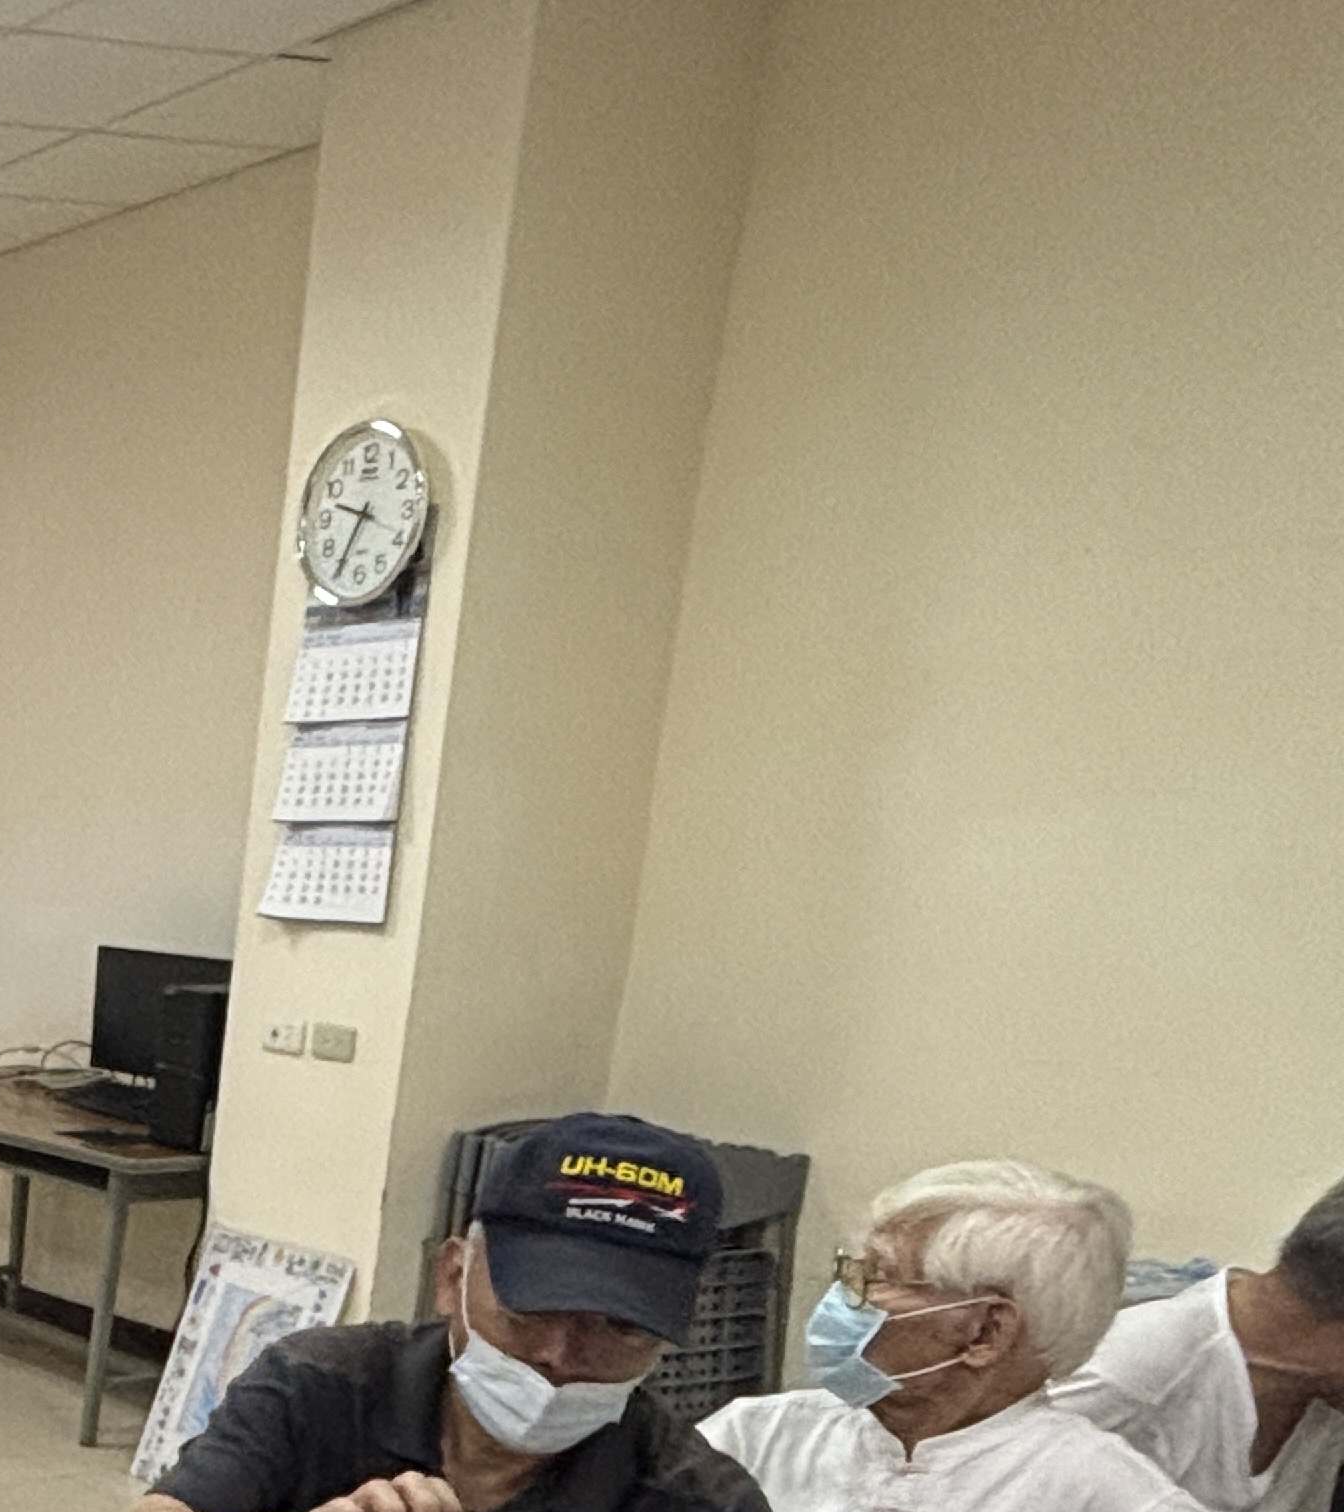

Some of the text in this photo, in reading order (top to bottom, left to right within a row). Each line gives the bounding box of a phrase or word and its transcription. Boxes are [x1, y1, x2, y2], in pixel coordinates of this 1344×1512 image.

[364, 442, 380, 464] 12
[342, 458, 355, 476] 11
[327, 478, 344, 499] 10
[395, 468, 410, 490] 2
[319, 509, 332, 530] 9
[401, 499, 414, 520] 3
[322, 538, 335, 559] 8
[392, 530, 405, 546] 4
[353, 563, 366, 585] 6
[561, 1154, 685, 1197] UH-60M
